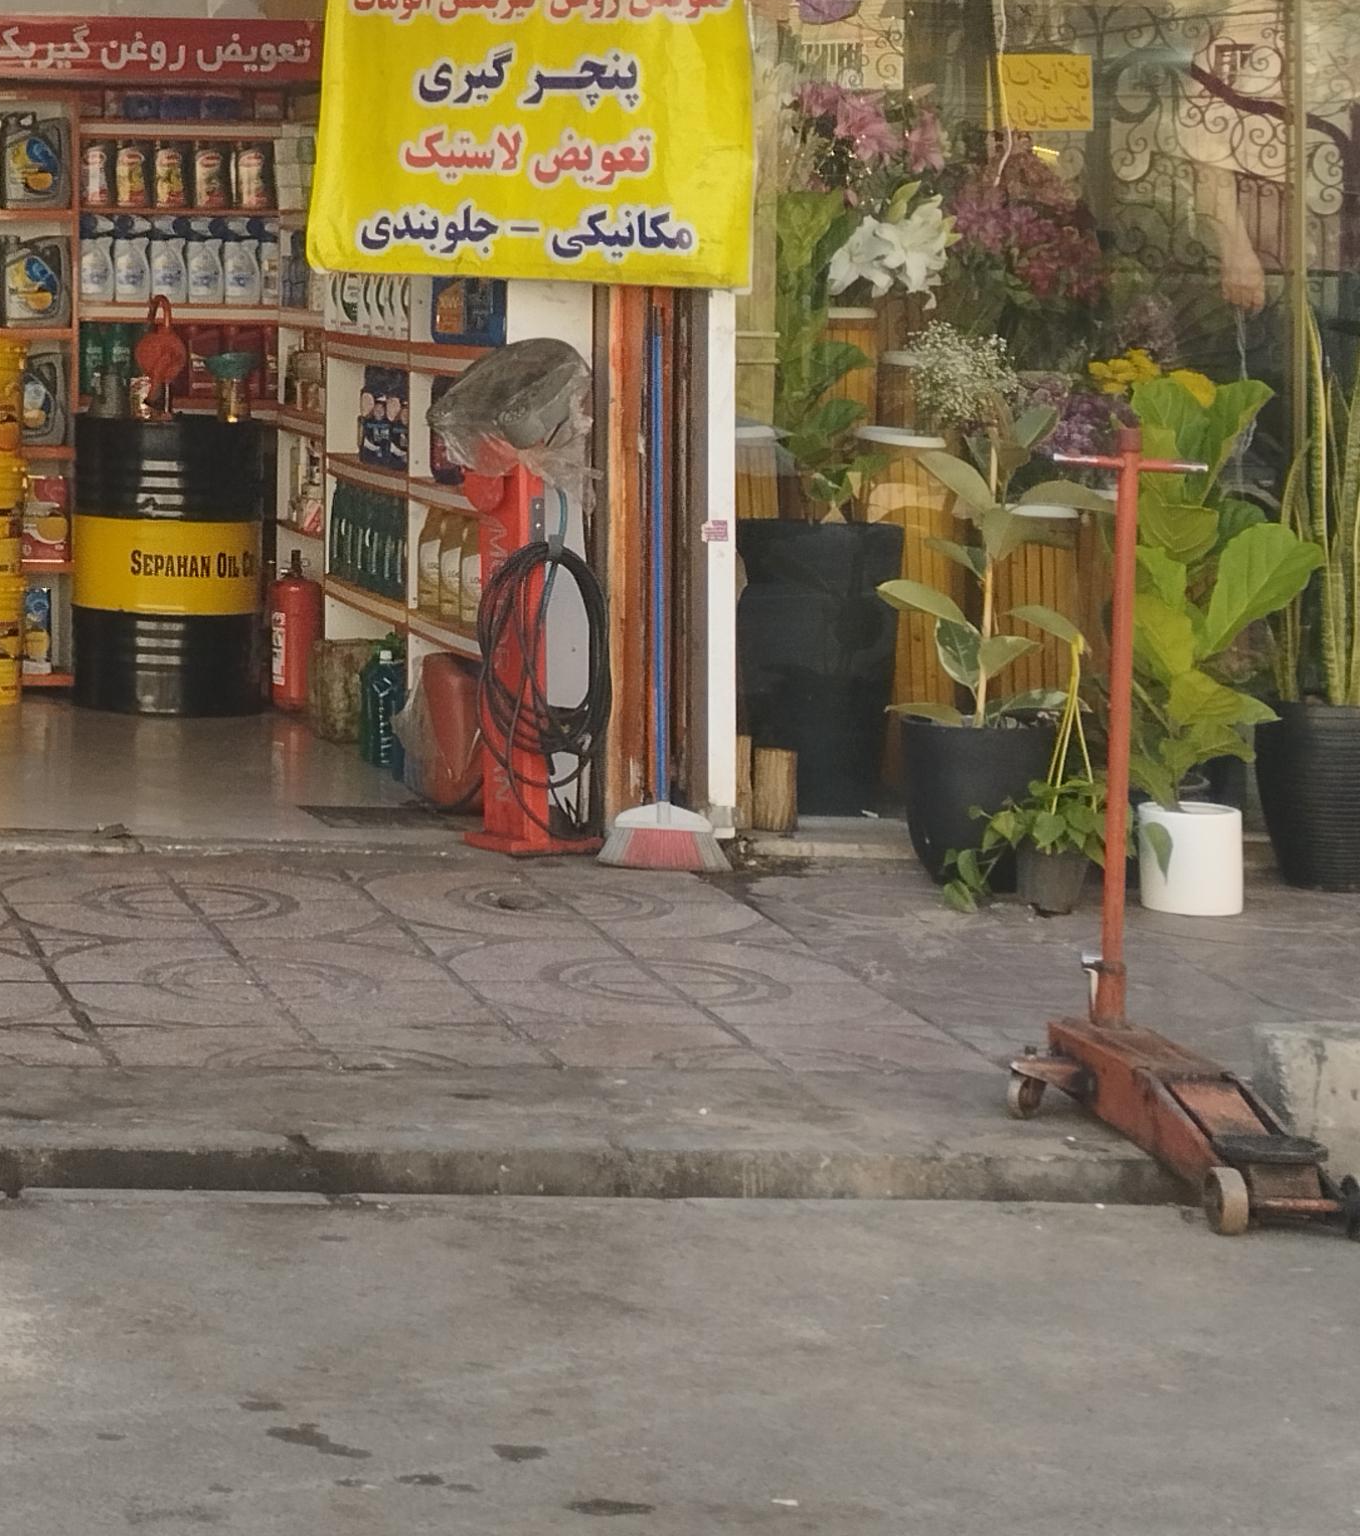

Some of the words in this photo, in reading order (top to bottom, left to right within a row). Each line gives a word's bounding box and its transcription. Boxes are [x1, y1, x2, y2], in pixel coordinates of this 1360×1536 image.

[100, 31, 187, 73] روغن
[196, 32, 312, 73] تعویض
[419, 47, 513, 104] گیری
[522, 50, 639, 107] پنچر
[403, 130, 522, 181] لاستیک
[533, 133, 652, 185] تعویض
[360, 204, 499, 255] جلوبندی
[551, 208, 694, 259] مکانیکی
[130, 549, 212, 578] SEPAHAN
[217, 552, 239, 579] OIL
